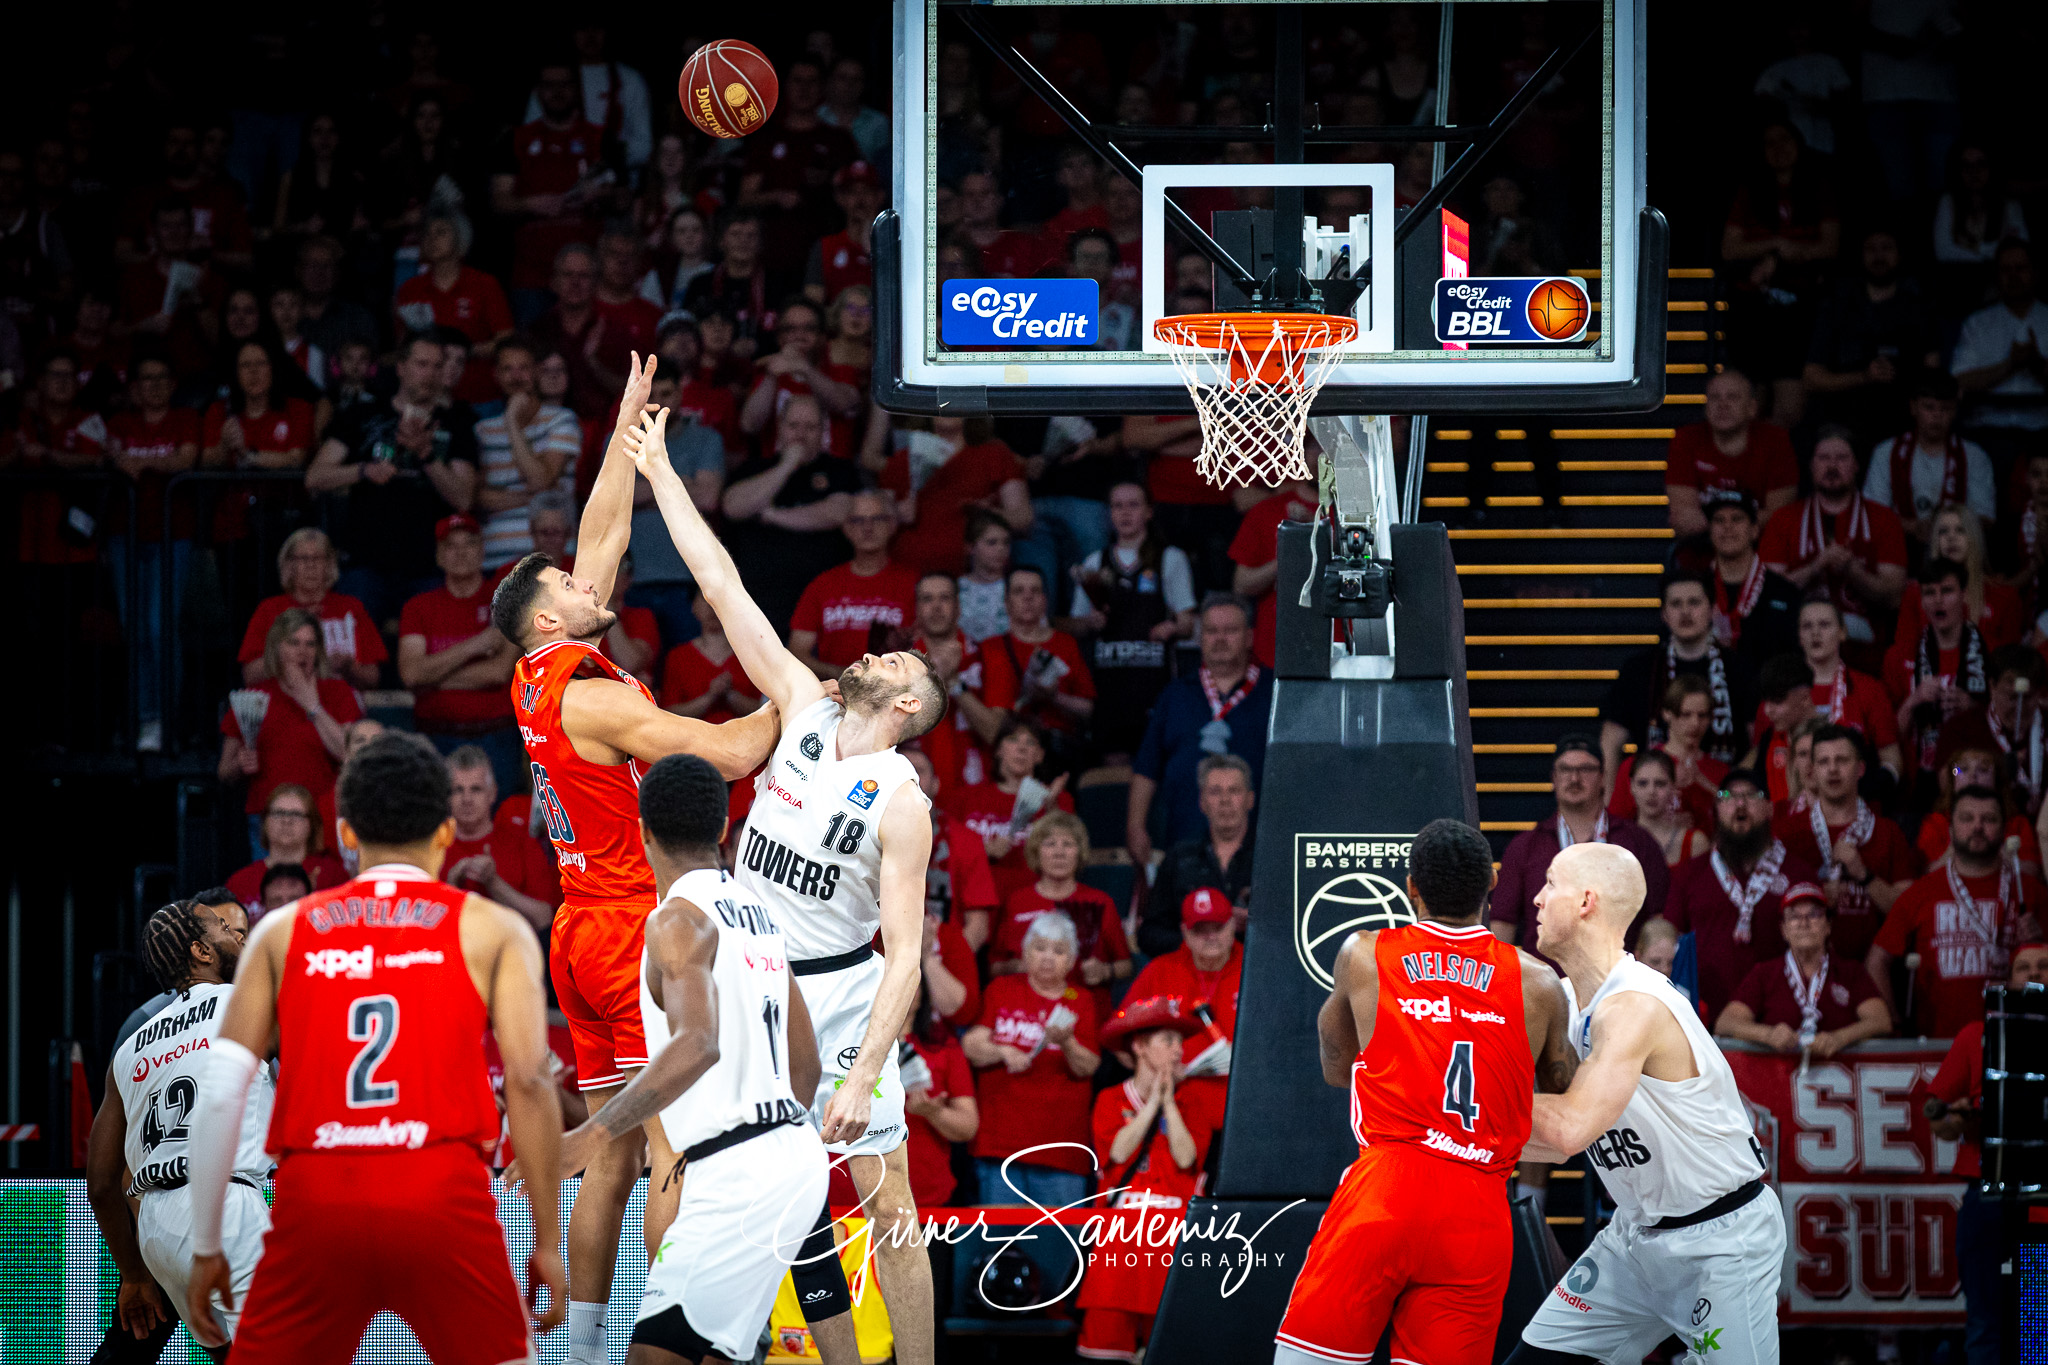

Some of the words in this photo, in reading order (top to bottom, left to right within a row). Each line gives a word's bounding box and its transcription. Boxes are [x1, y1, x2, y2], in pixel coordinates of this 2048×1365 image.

[1466, 297, 1512, 309] Credit
[992, 311, 1089, 338] Credit
[1447, 311, 1511, 336] BBL
[785, 760, 805, 779] CRAFT
[773, 783, 803, 810] VEOLIA
[821, 811, 867, 856] 18
[1306, 842, 1414, 857] BAMBERG
[742, 825, 841, 902] TOWERS
[309, 896, 450, 935] COPELAND
[305, 945, 374, 979] xpd
[1401, 951, 1495, 993] NELSON
[134, 996, 219, 1055] DURHAM
[1397, 996, 1451, 1021] xpd
[1460, 1008, 1506, 1025] logistics
[152, 1037, 210, 1070] VEOLIA
[346, 993, 401, 1110] 2
[1442, 1040, 1480, 1133] 4
[141, 1075, 200, 1155] 42
[867, 1126, 894, 1137] CRAFT
[313, 1116, 430, 1150] Bamberg
